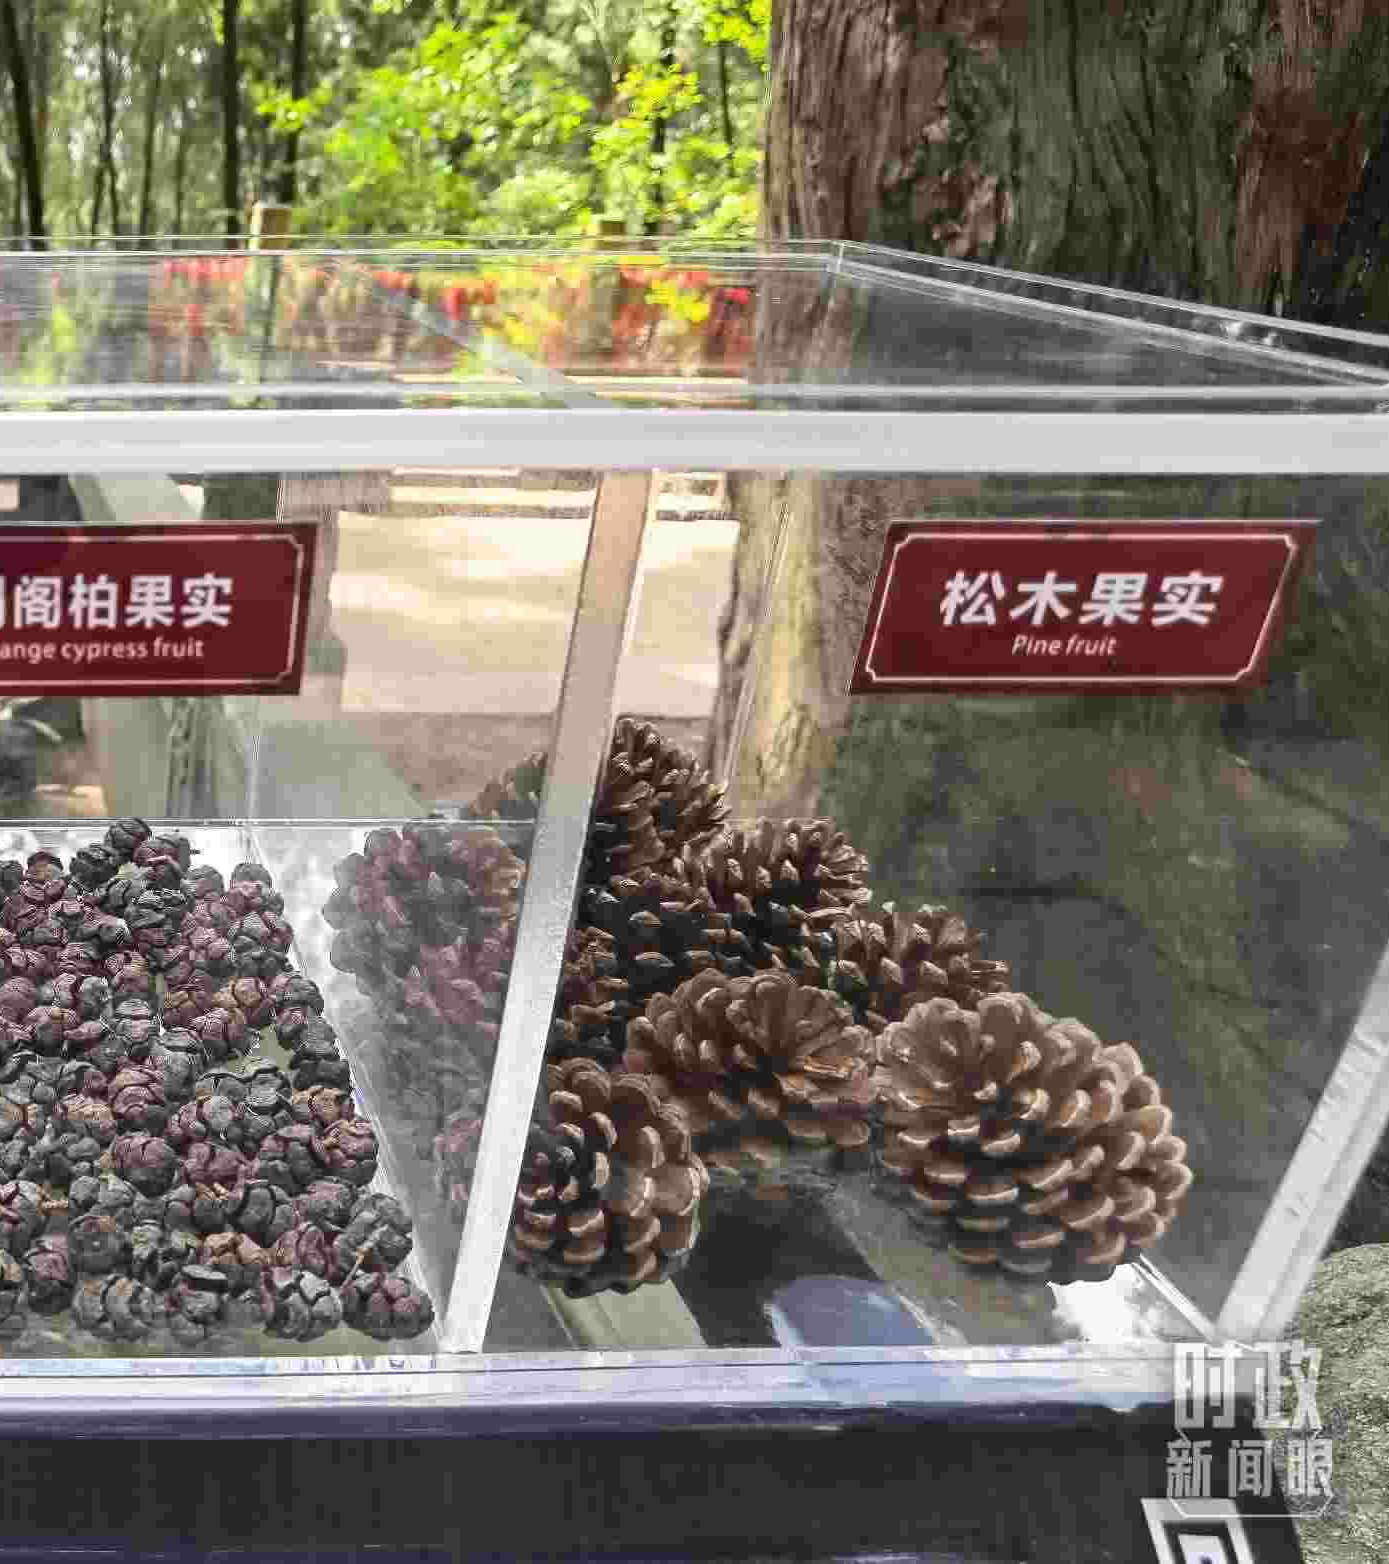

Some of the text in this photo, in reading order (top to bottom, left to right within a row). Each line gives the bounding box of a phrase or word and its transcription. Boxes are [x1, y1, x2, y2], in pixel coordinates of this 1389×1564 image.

[939, 570, 1224, 626] 松木果实
[60, 641, 148, 663] cypress
[152, 637, 205, 658] fruit
[1012, 634, 1117, 657] Pine fruit
